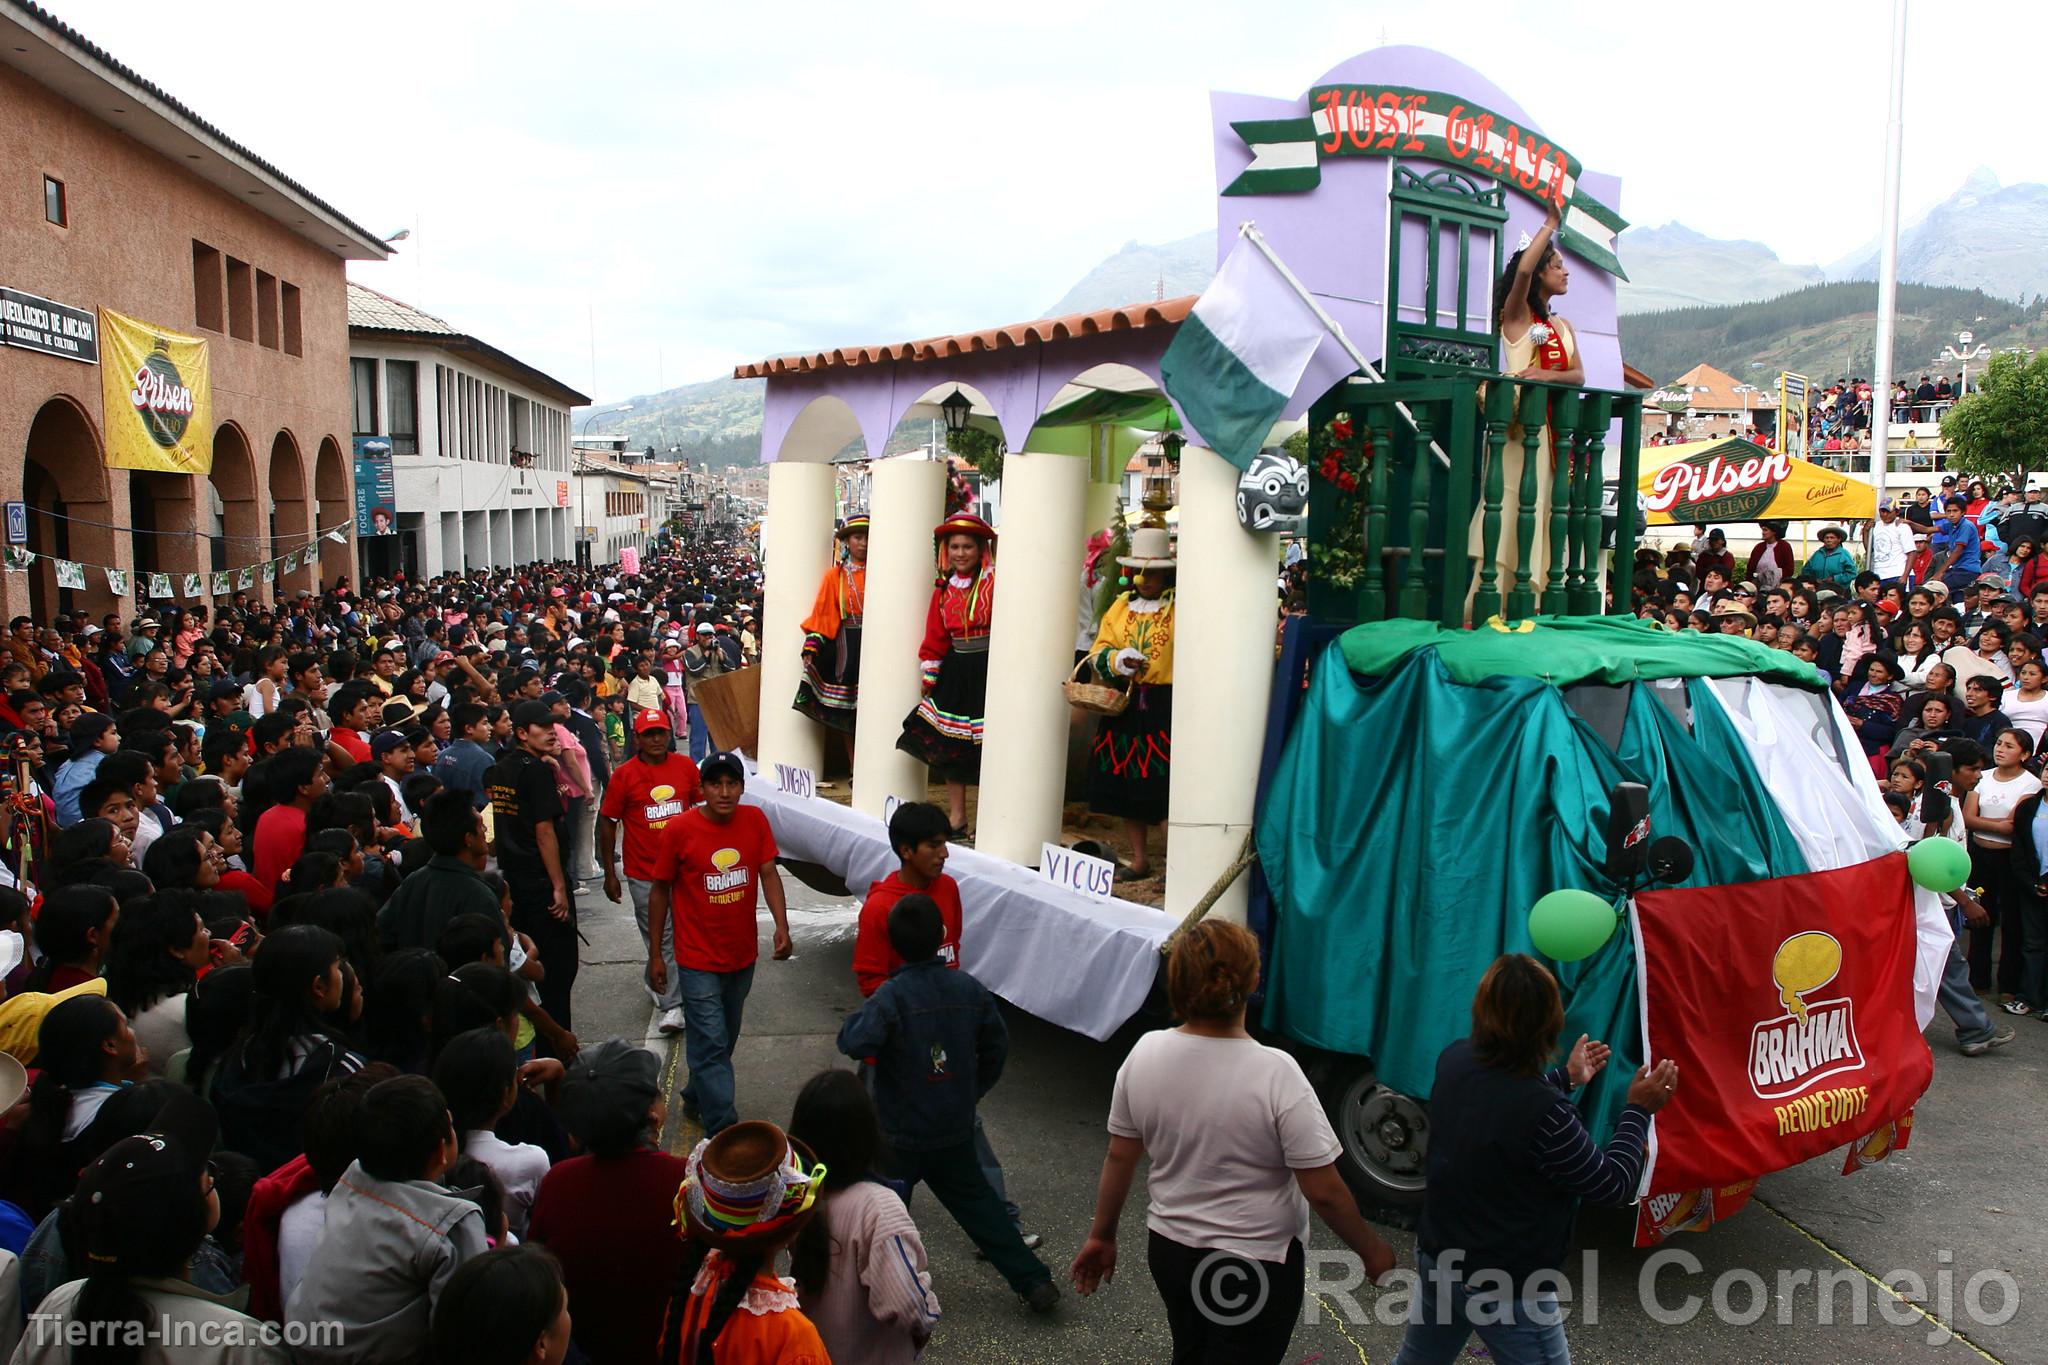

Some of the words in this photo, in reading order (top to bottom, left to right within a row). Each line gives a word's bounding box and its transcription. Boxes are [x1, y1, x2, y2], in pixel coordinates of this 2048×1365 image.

[1317, 89, 1427, 154] JOSE
[1445, 105, 1568, 209] OLAYA
[50, 312, 61, 334] DE
[63, 316, 92, 342] ANCASH
[44, 333, 52, 346] DE
[54, 336, 79, 352] CULTURA
[131, 365, 194, 414] Pilsen
[1648, 390, 1694, 403] Pilsen
[1646, 453, 1793, 512] Pilsen
[1806, 479, 1848, 501] Calidad
[1693, 494, 1758, 521] CALLAO
[774, 763, 811, 799] YUNGAY
[646, 800, 683, 819] BRAHMA
[706, 868, 747, 891] BRAHMA
[1046, 849, 1112, 895] VICUS
[1754, 1007, 1854, 1086] BRAHMA
